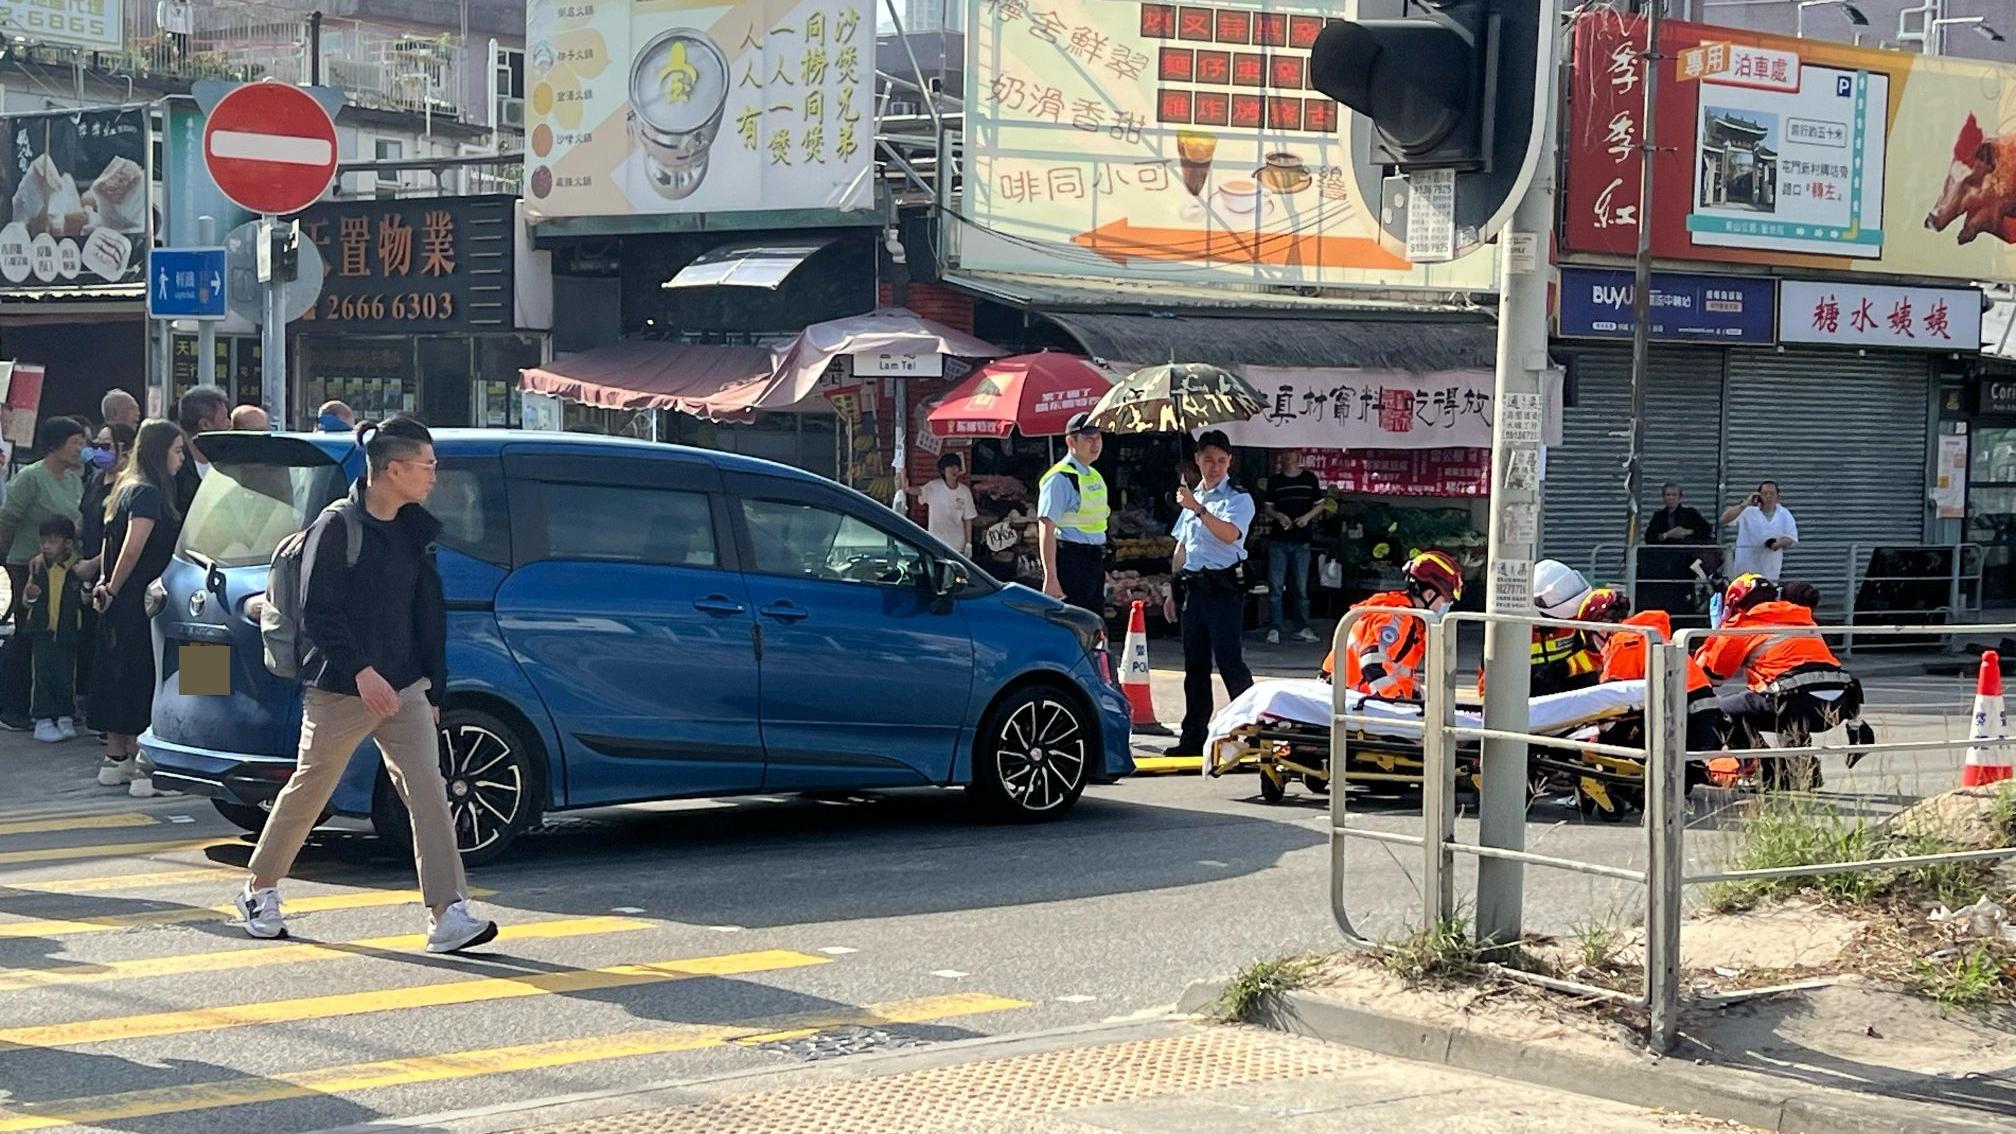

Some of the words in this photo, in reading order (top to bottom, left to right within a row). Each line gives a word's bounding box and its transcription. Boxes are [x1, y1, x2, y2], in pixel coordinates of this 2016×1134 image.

[1684, 44, 1725, 77] 專用
[1735, 52, 1788, 84] 泊車處
[1594, 40, 1639, 229] 季季紅
[1000, 160, 1172, 203] 啡同小可
[303, 210, 457, 278] 置物業
[327, 294, 385, 320] 2666
[391, 291, 453, 320] 6303
[1811, 293, 1952, 340] 糖水姨姨
[880, 361, 899, 371] Lam
[902, 360, 917, 371] Tei
[1132, 661, 1149, 673] PO
